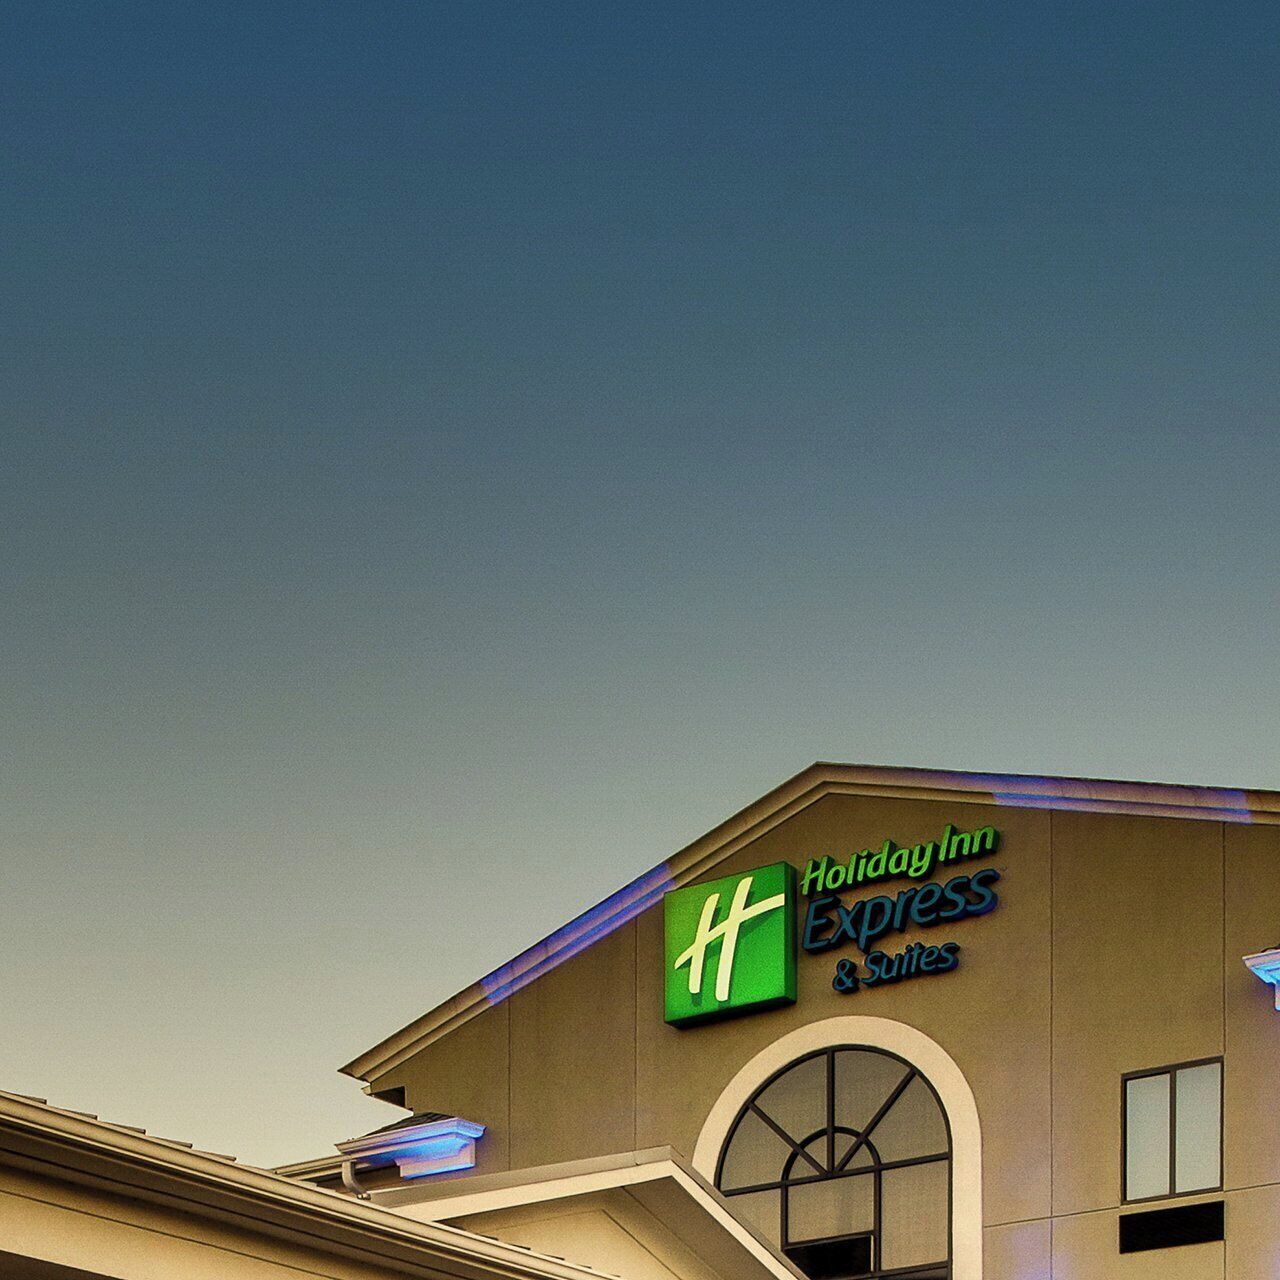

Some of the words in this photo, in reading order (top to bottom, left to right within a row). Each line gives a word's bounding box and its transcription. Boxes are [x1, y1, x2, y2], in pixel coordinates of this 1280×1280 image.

[800, 840, 936, 896] Holiday
[938, 824, 998, 861] Inn
[803, 869, 999, 952] Express
[832, 958, 859, 993] &
[861, 942, 960, 986] Suites
